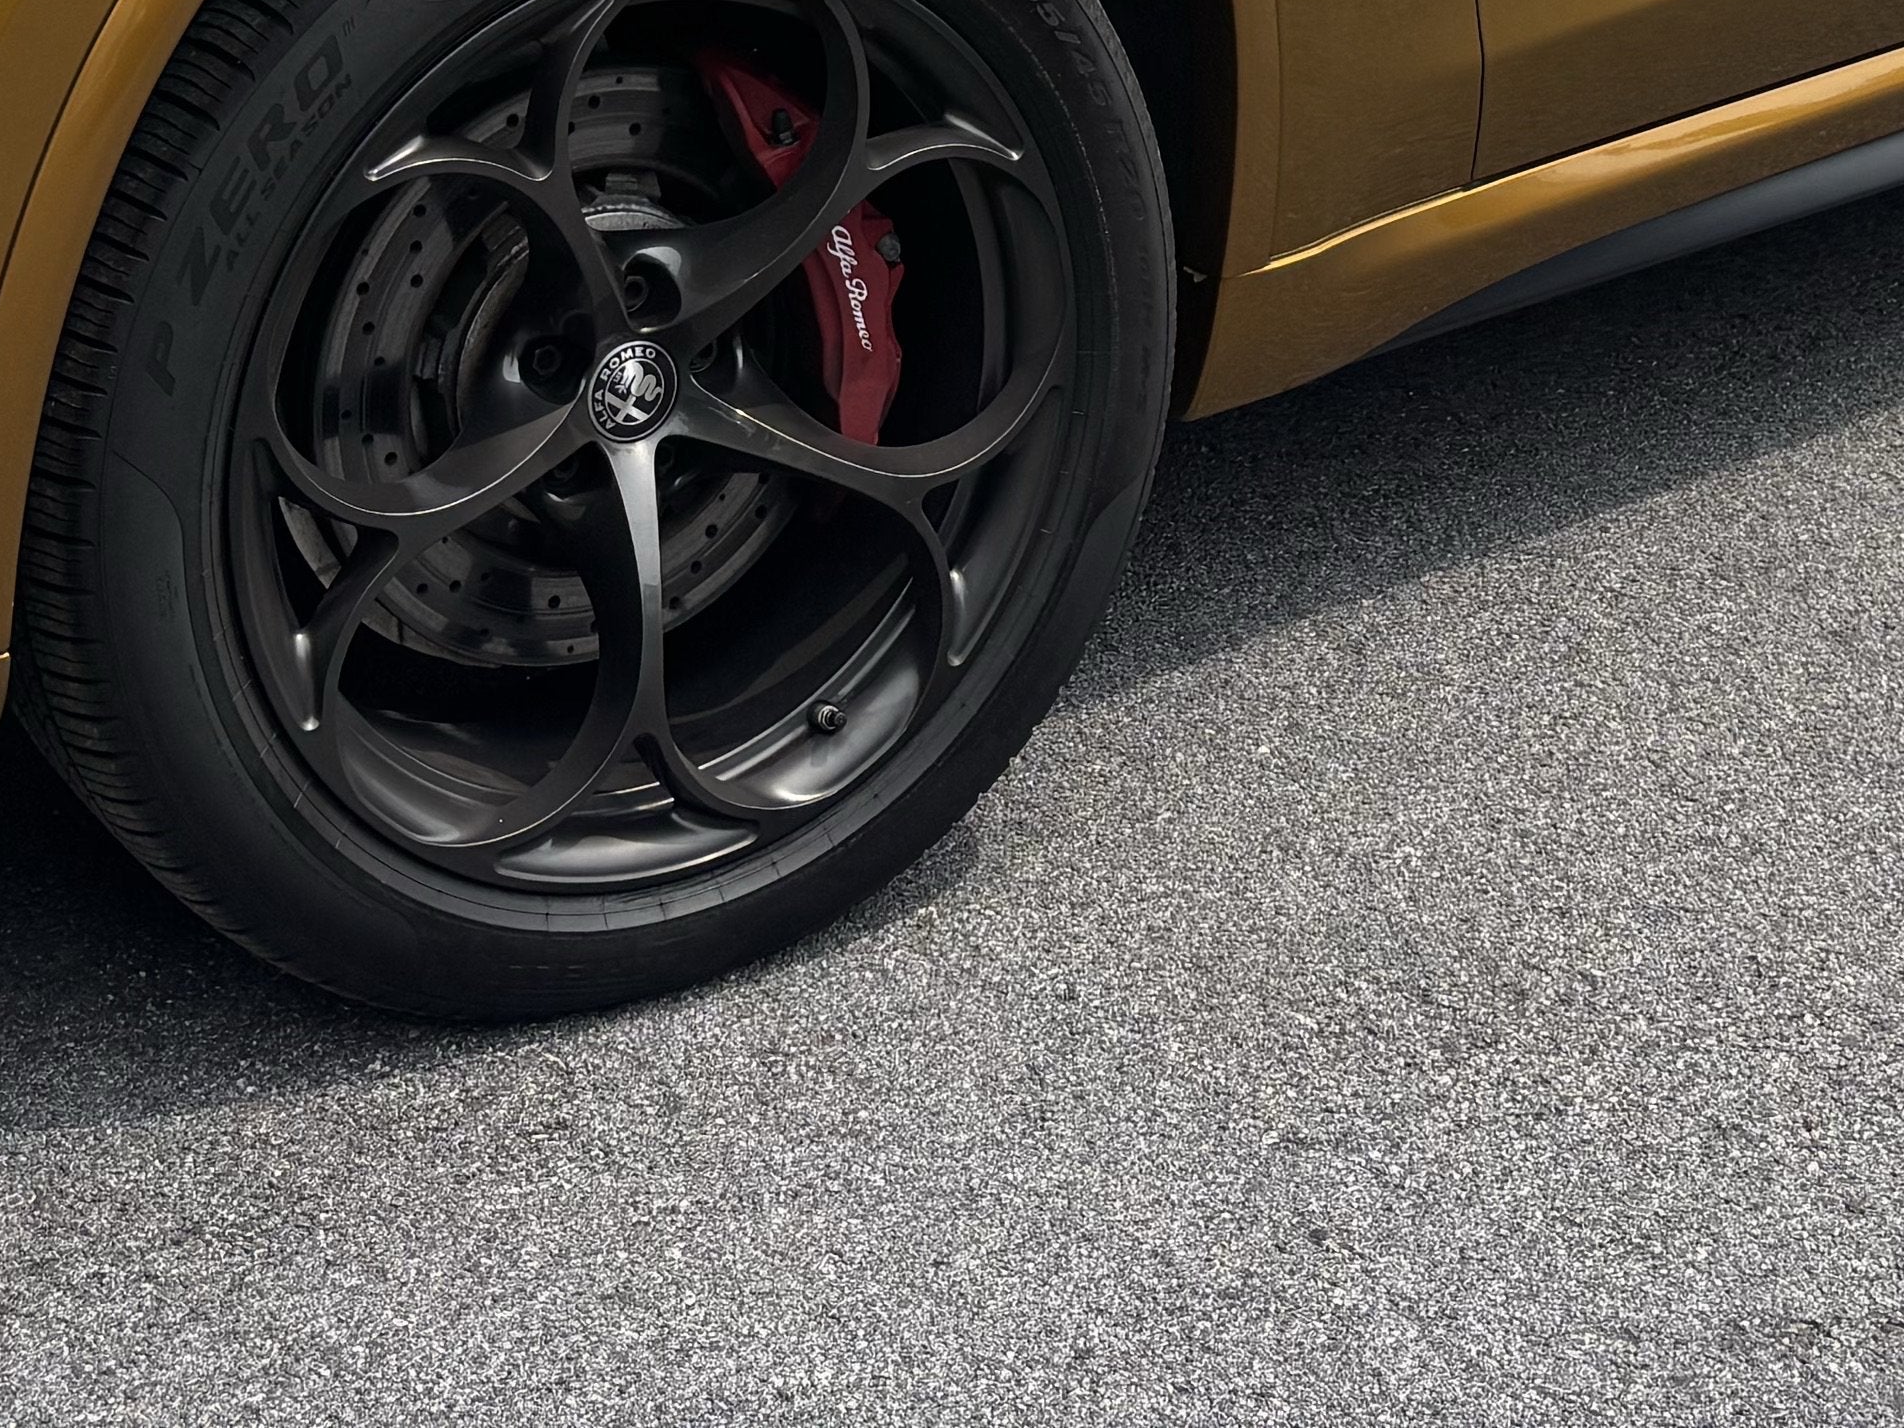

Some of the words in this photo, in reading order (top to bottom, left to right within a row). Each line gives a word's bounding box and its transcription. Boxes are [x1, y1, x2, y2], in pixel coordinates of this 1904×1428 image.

[145, 320, 177, 398] P
[176, 34, 344, 307] ZERO
[226, 209, 260, 273] ALL
[259, 72, 353, 202] SEASON
[826, 225, 858, 279] Alfa
[844, 278, 873, 352] Romeo
[593, 388, 617, 430] ALFA
[599, 346, 656, 382] ROMEO
